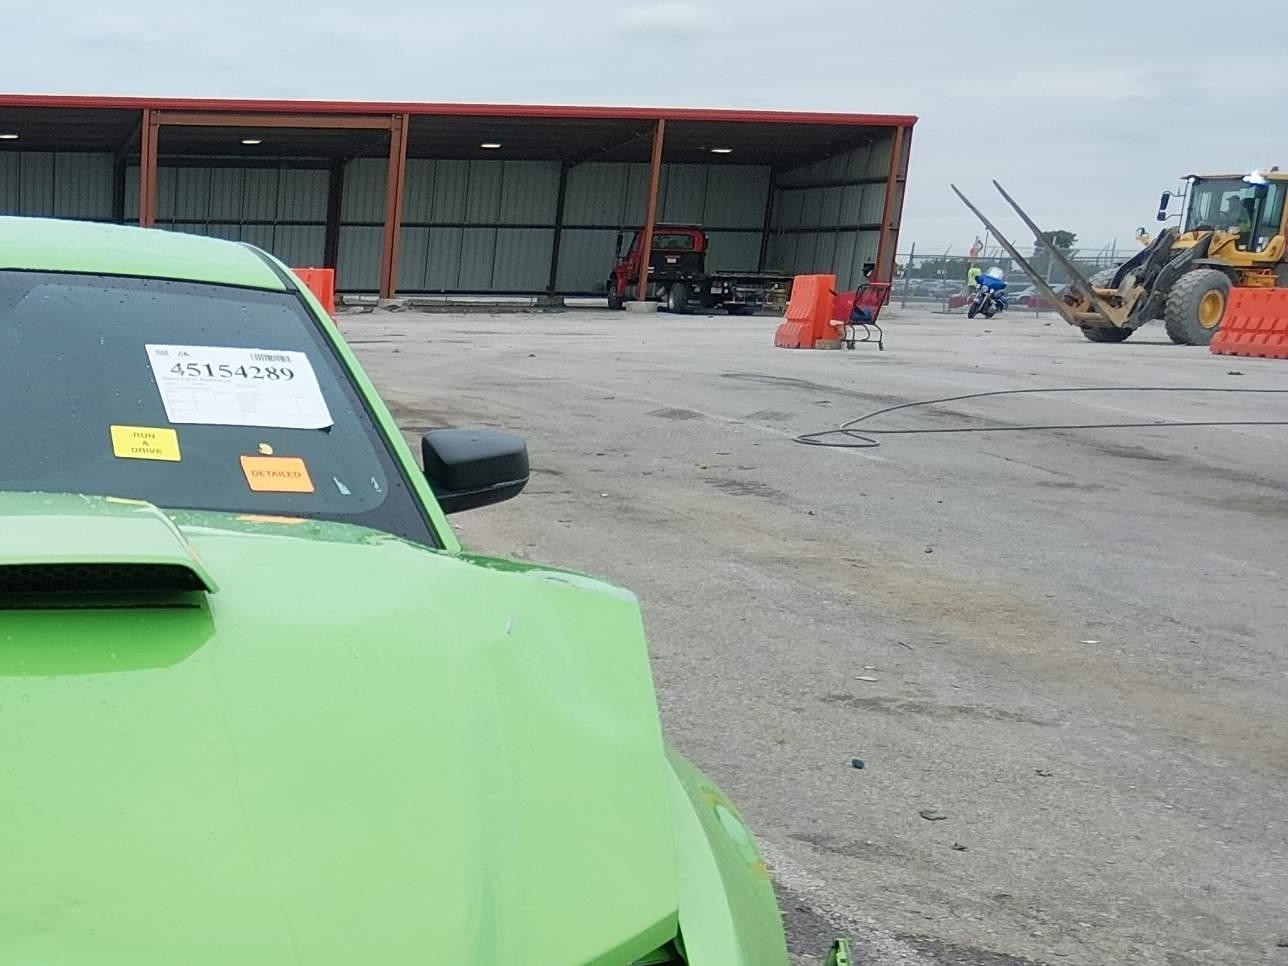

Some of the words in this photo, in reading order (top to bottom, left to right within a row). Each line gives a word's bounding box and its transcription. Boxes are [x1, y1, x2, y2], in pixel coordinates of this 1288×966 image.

[170, 362, 295, 381] 45154289
[132, 432, 156, 440] RUN
[130, 446, 162, 455] DRIVE
[250, 469, 302, 478] DETAILED
